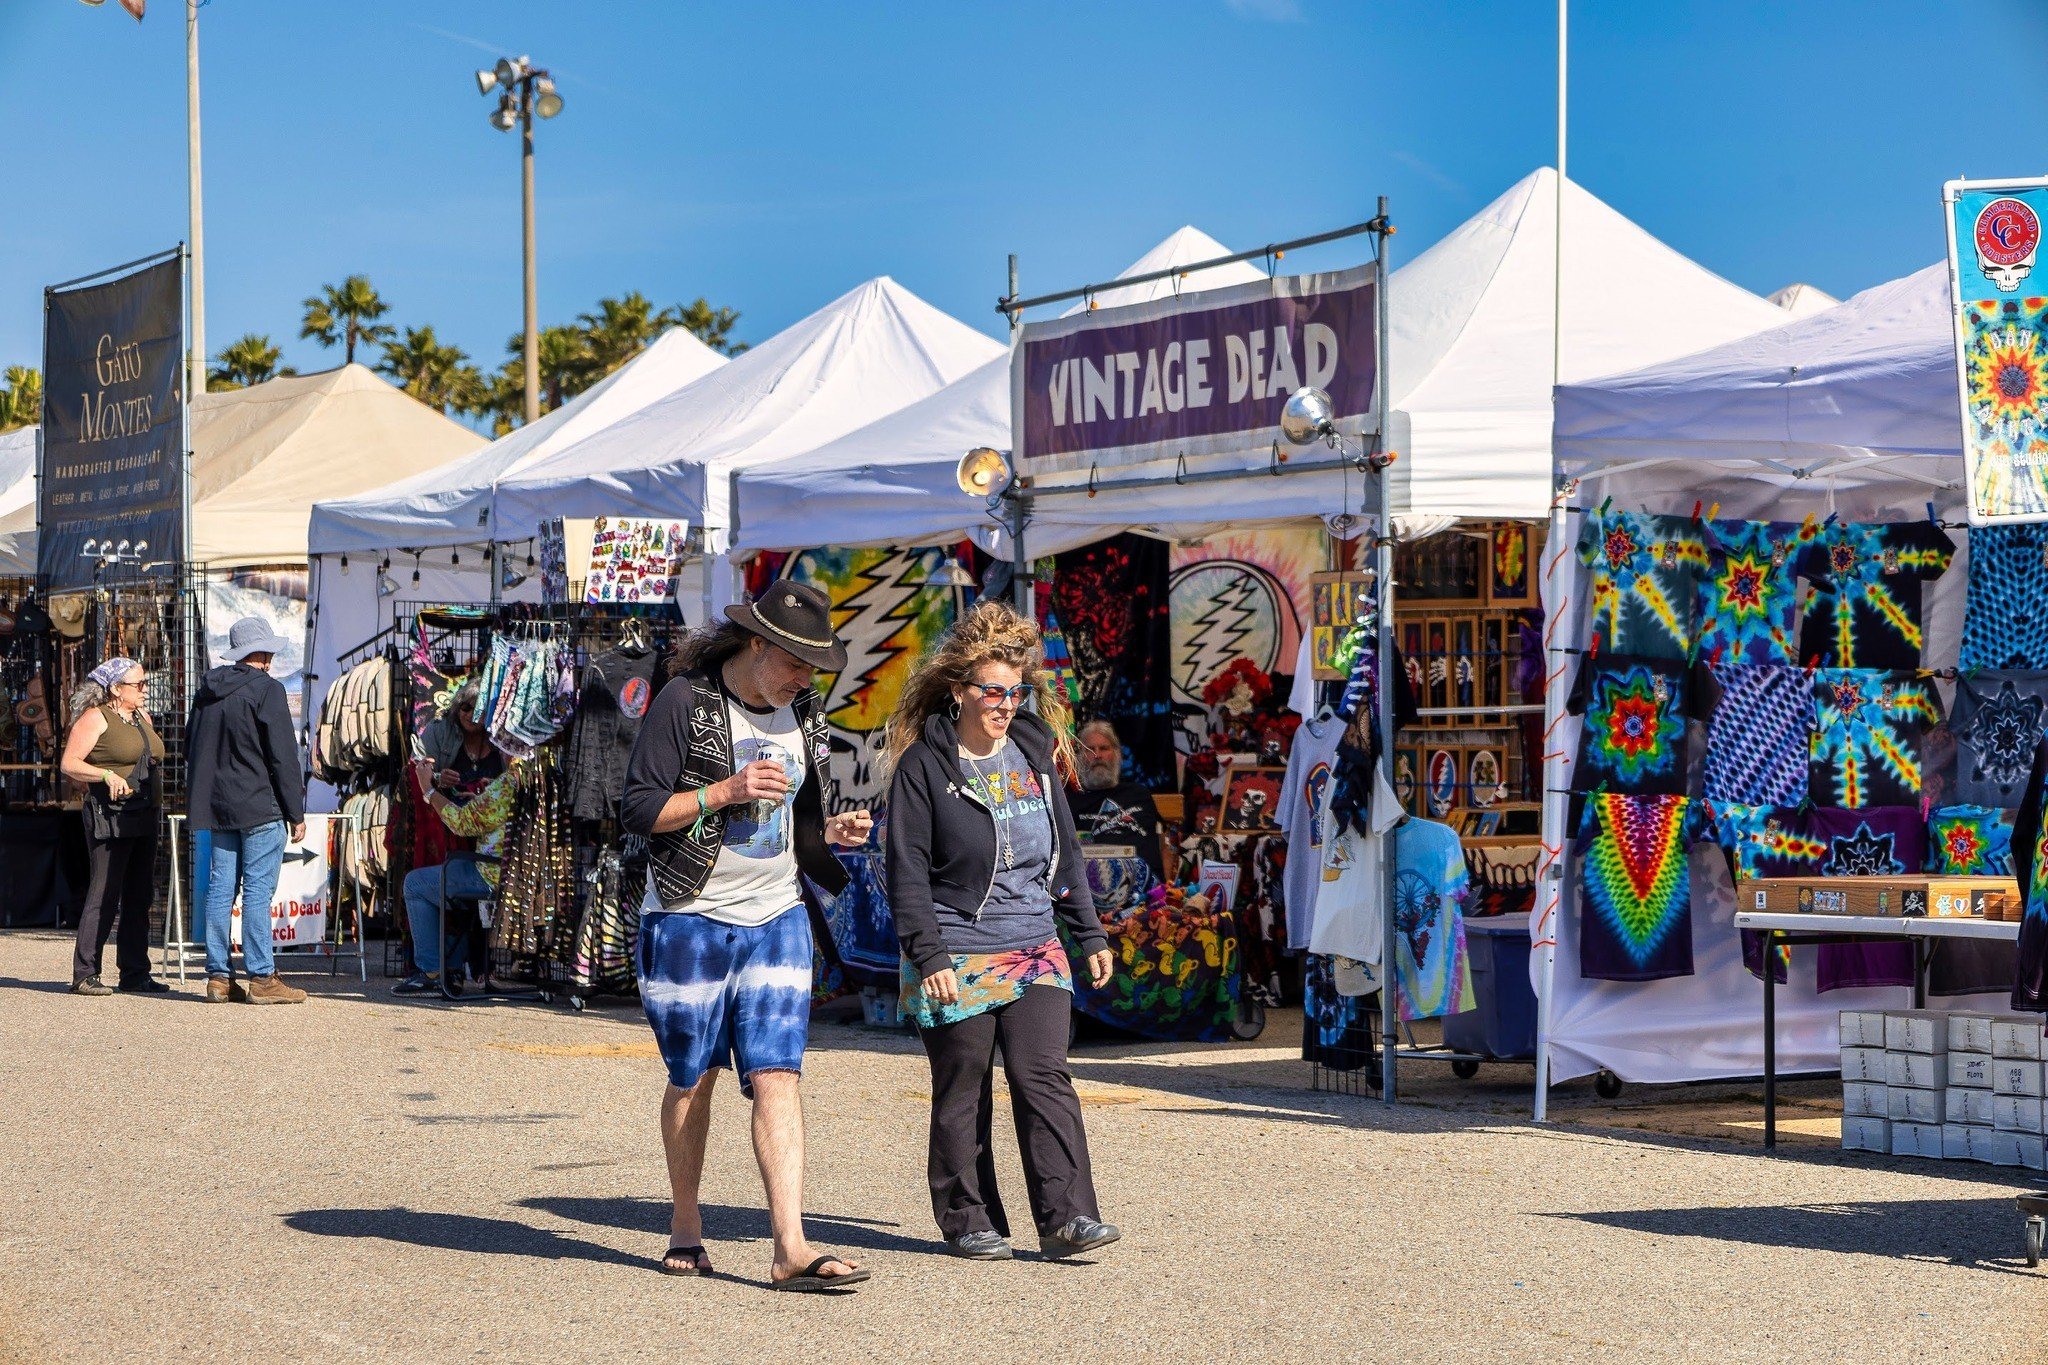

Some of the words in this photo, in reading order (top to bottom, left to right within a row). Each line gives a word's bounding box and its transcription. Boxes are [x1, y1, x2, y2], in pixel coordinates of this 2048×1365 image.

[1979, 201, 2037, 235] CUMBERLAND
[1981, 239, 2035, 264] COASTERS
[96, 333, 142, 387] GATO
[1049, 338, 1213, 427] VINTAGE
[1225, 322, 1339, 405] DEAD
[79, 391, 153, 443] MONTES
[55, 460, 112, 479] HANDCRAFTED
[289, 898, 322, 918] Dead
